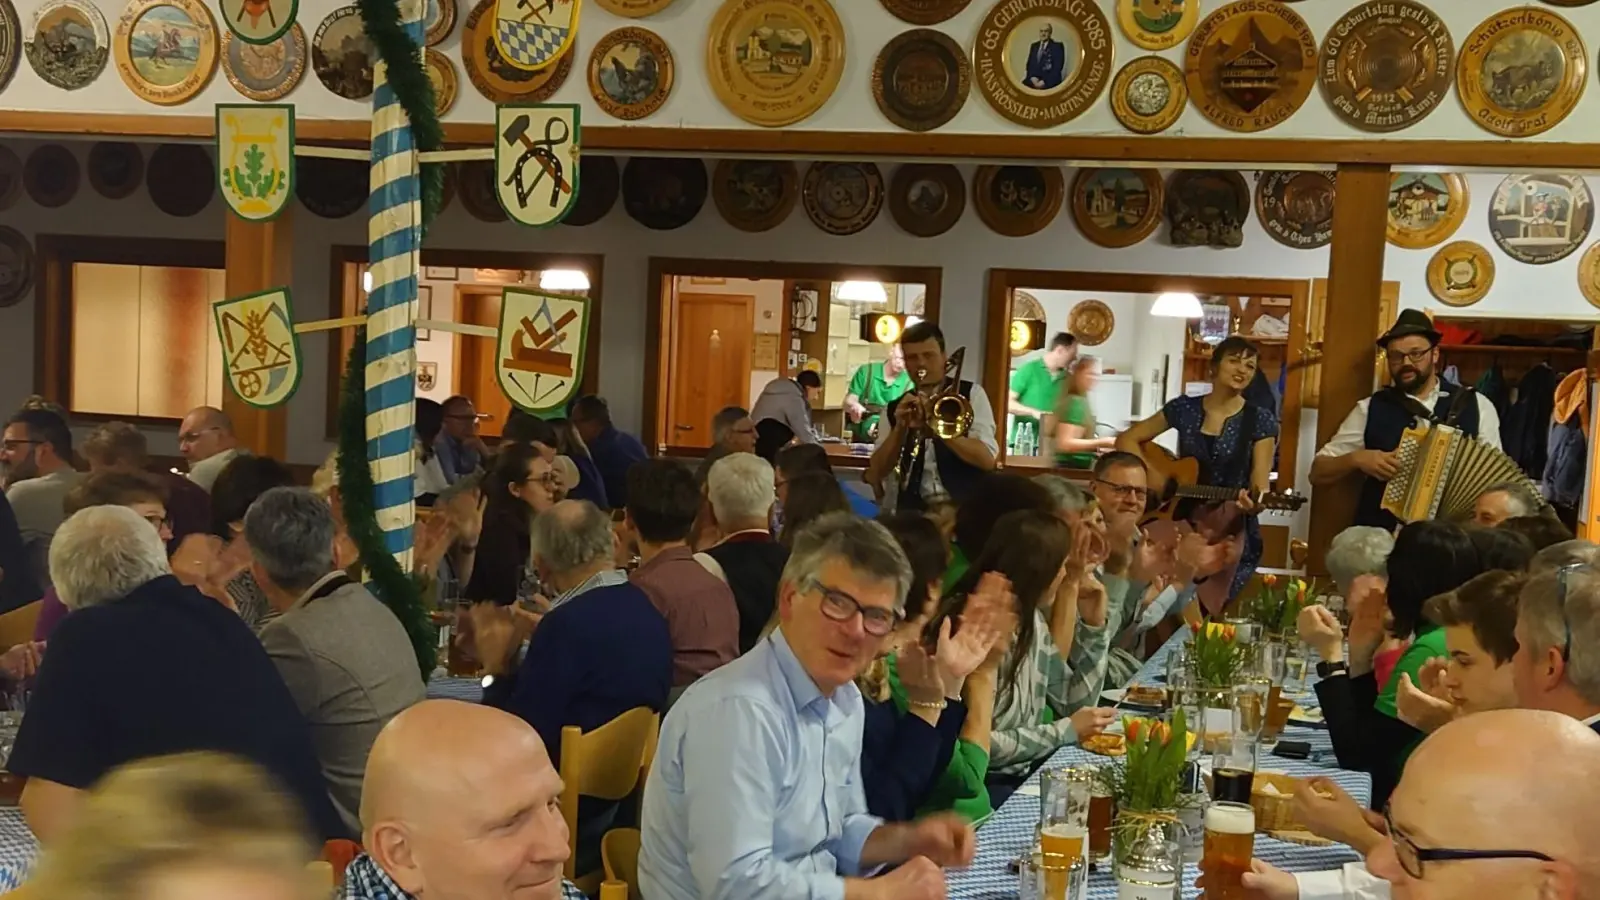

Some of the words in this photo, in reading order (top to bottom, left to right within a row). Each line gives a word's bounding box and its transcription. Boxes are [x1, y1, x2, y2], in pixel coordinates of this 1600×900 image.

[1082, 14, 1107, 50] 1985
[1327, 37, 1341, 56] 60
[1336, 3, 1395, 36] Geburtstag
[980, 58, 998, 92] HANS
[1043, 93, 1085, 120] MARTIN
[1081, 60, 1105, 98] KUNZE
[1203, 104, 1244, 128] ALFRED
[1254, 104, 1295, 128] RAUCH
[1365, 111, 1404, 125] Martin
[1478, 108, 1514, 130] Adolf
[1518, 113, 1548, 131] Graf
